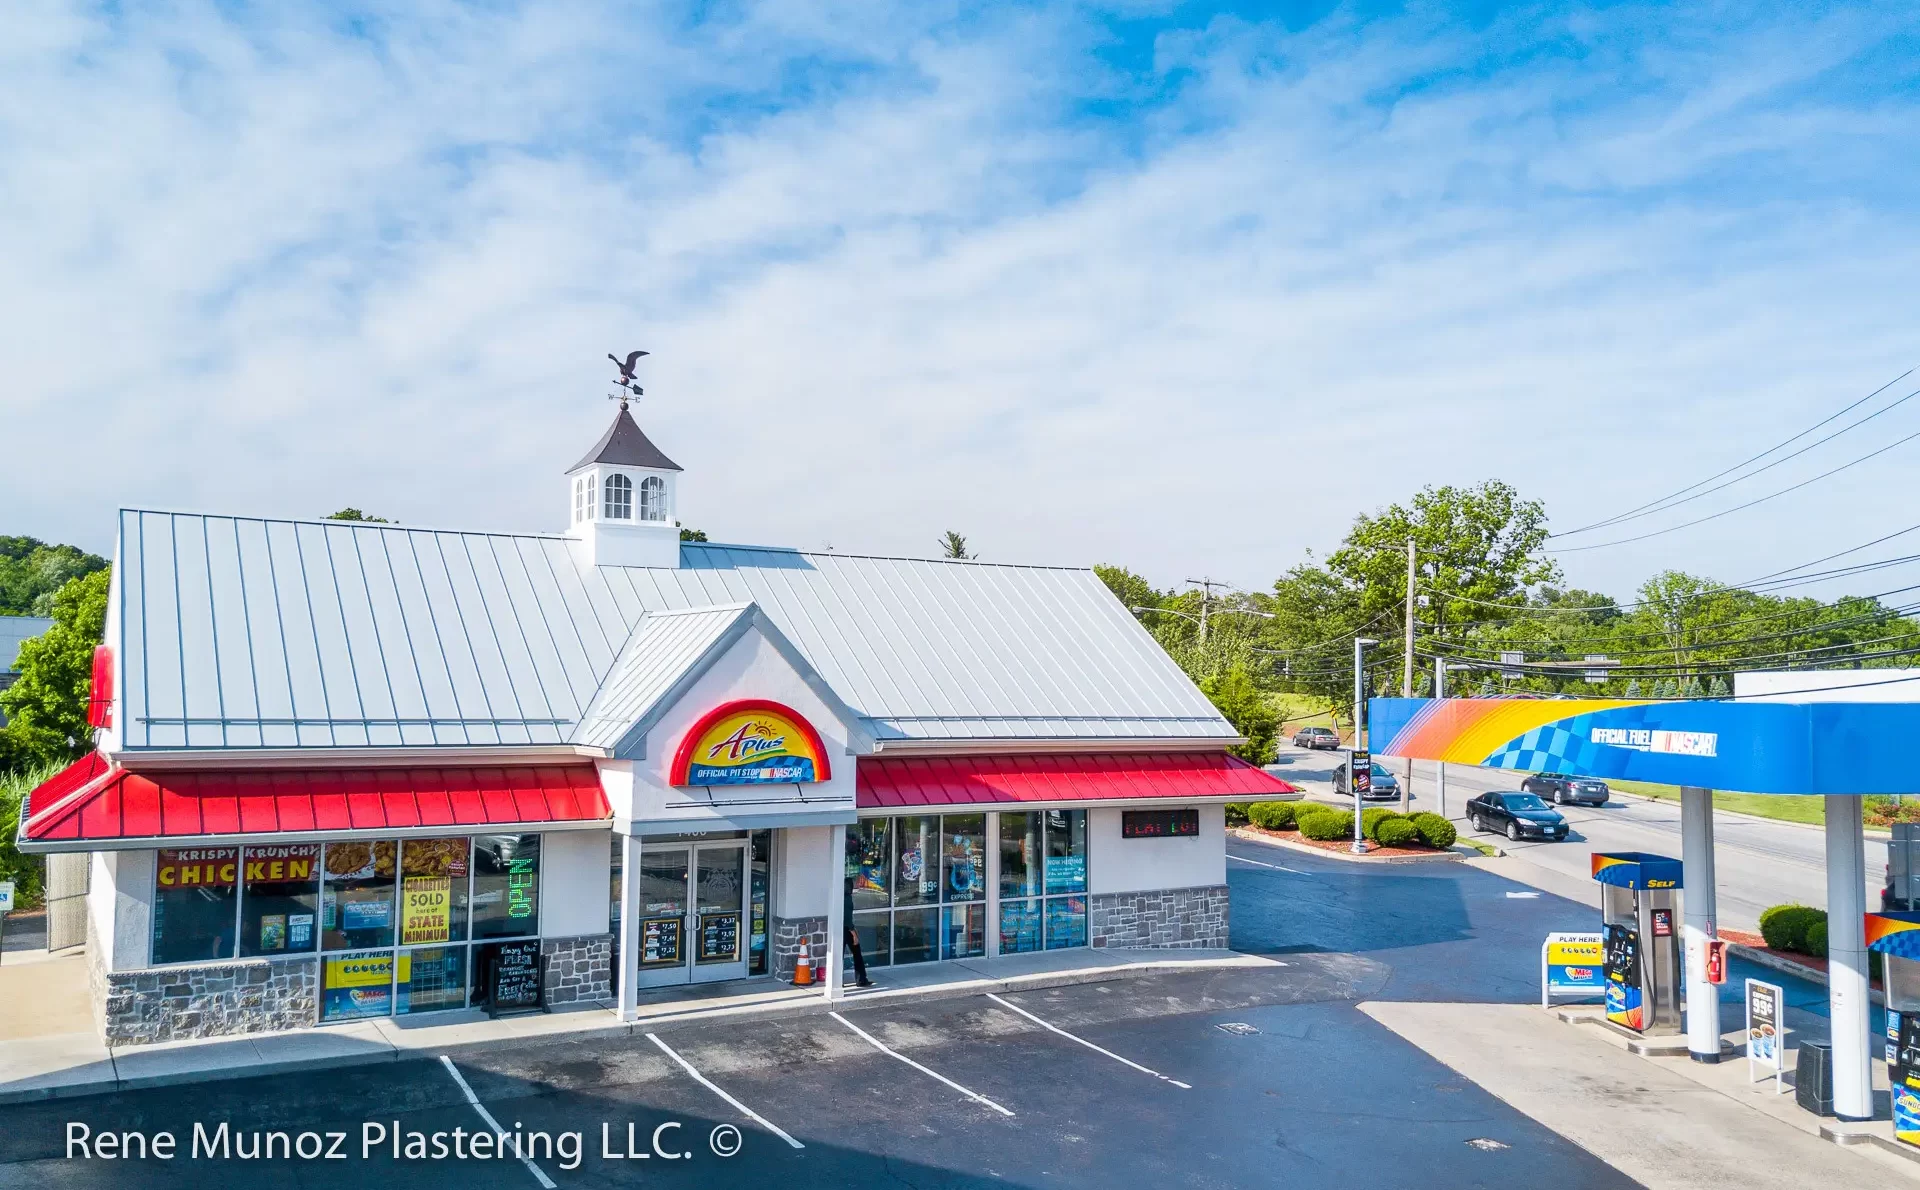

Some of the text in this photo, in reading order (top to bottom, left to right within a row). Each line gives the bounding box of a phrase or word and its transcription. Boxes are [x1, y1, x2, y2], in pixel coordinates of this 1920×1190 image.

[1591, 728, 1651, 745] OFFICIAL FUEL
[1670, 731, 1718, 756] NASCAR
[697, 767, 803, 778] OFFICIAL PIT STOP NASCAR
[178, 845, 320, 861] KRISPY KRUNCHY
[159, 860, 309, 886] CHICKEN
[509, 859, 533, 918] OPEN
[1628, 880, 1634, 888] 1
[410, 893, 444, 907] SOLD
[409, 915, 444, 929] STATE
[404, 929, 448, 943] MINIMUM
[341, 951, 366, 960] PLAY
[1752, 997, 1773, 1016] 99¢
